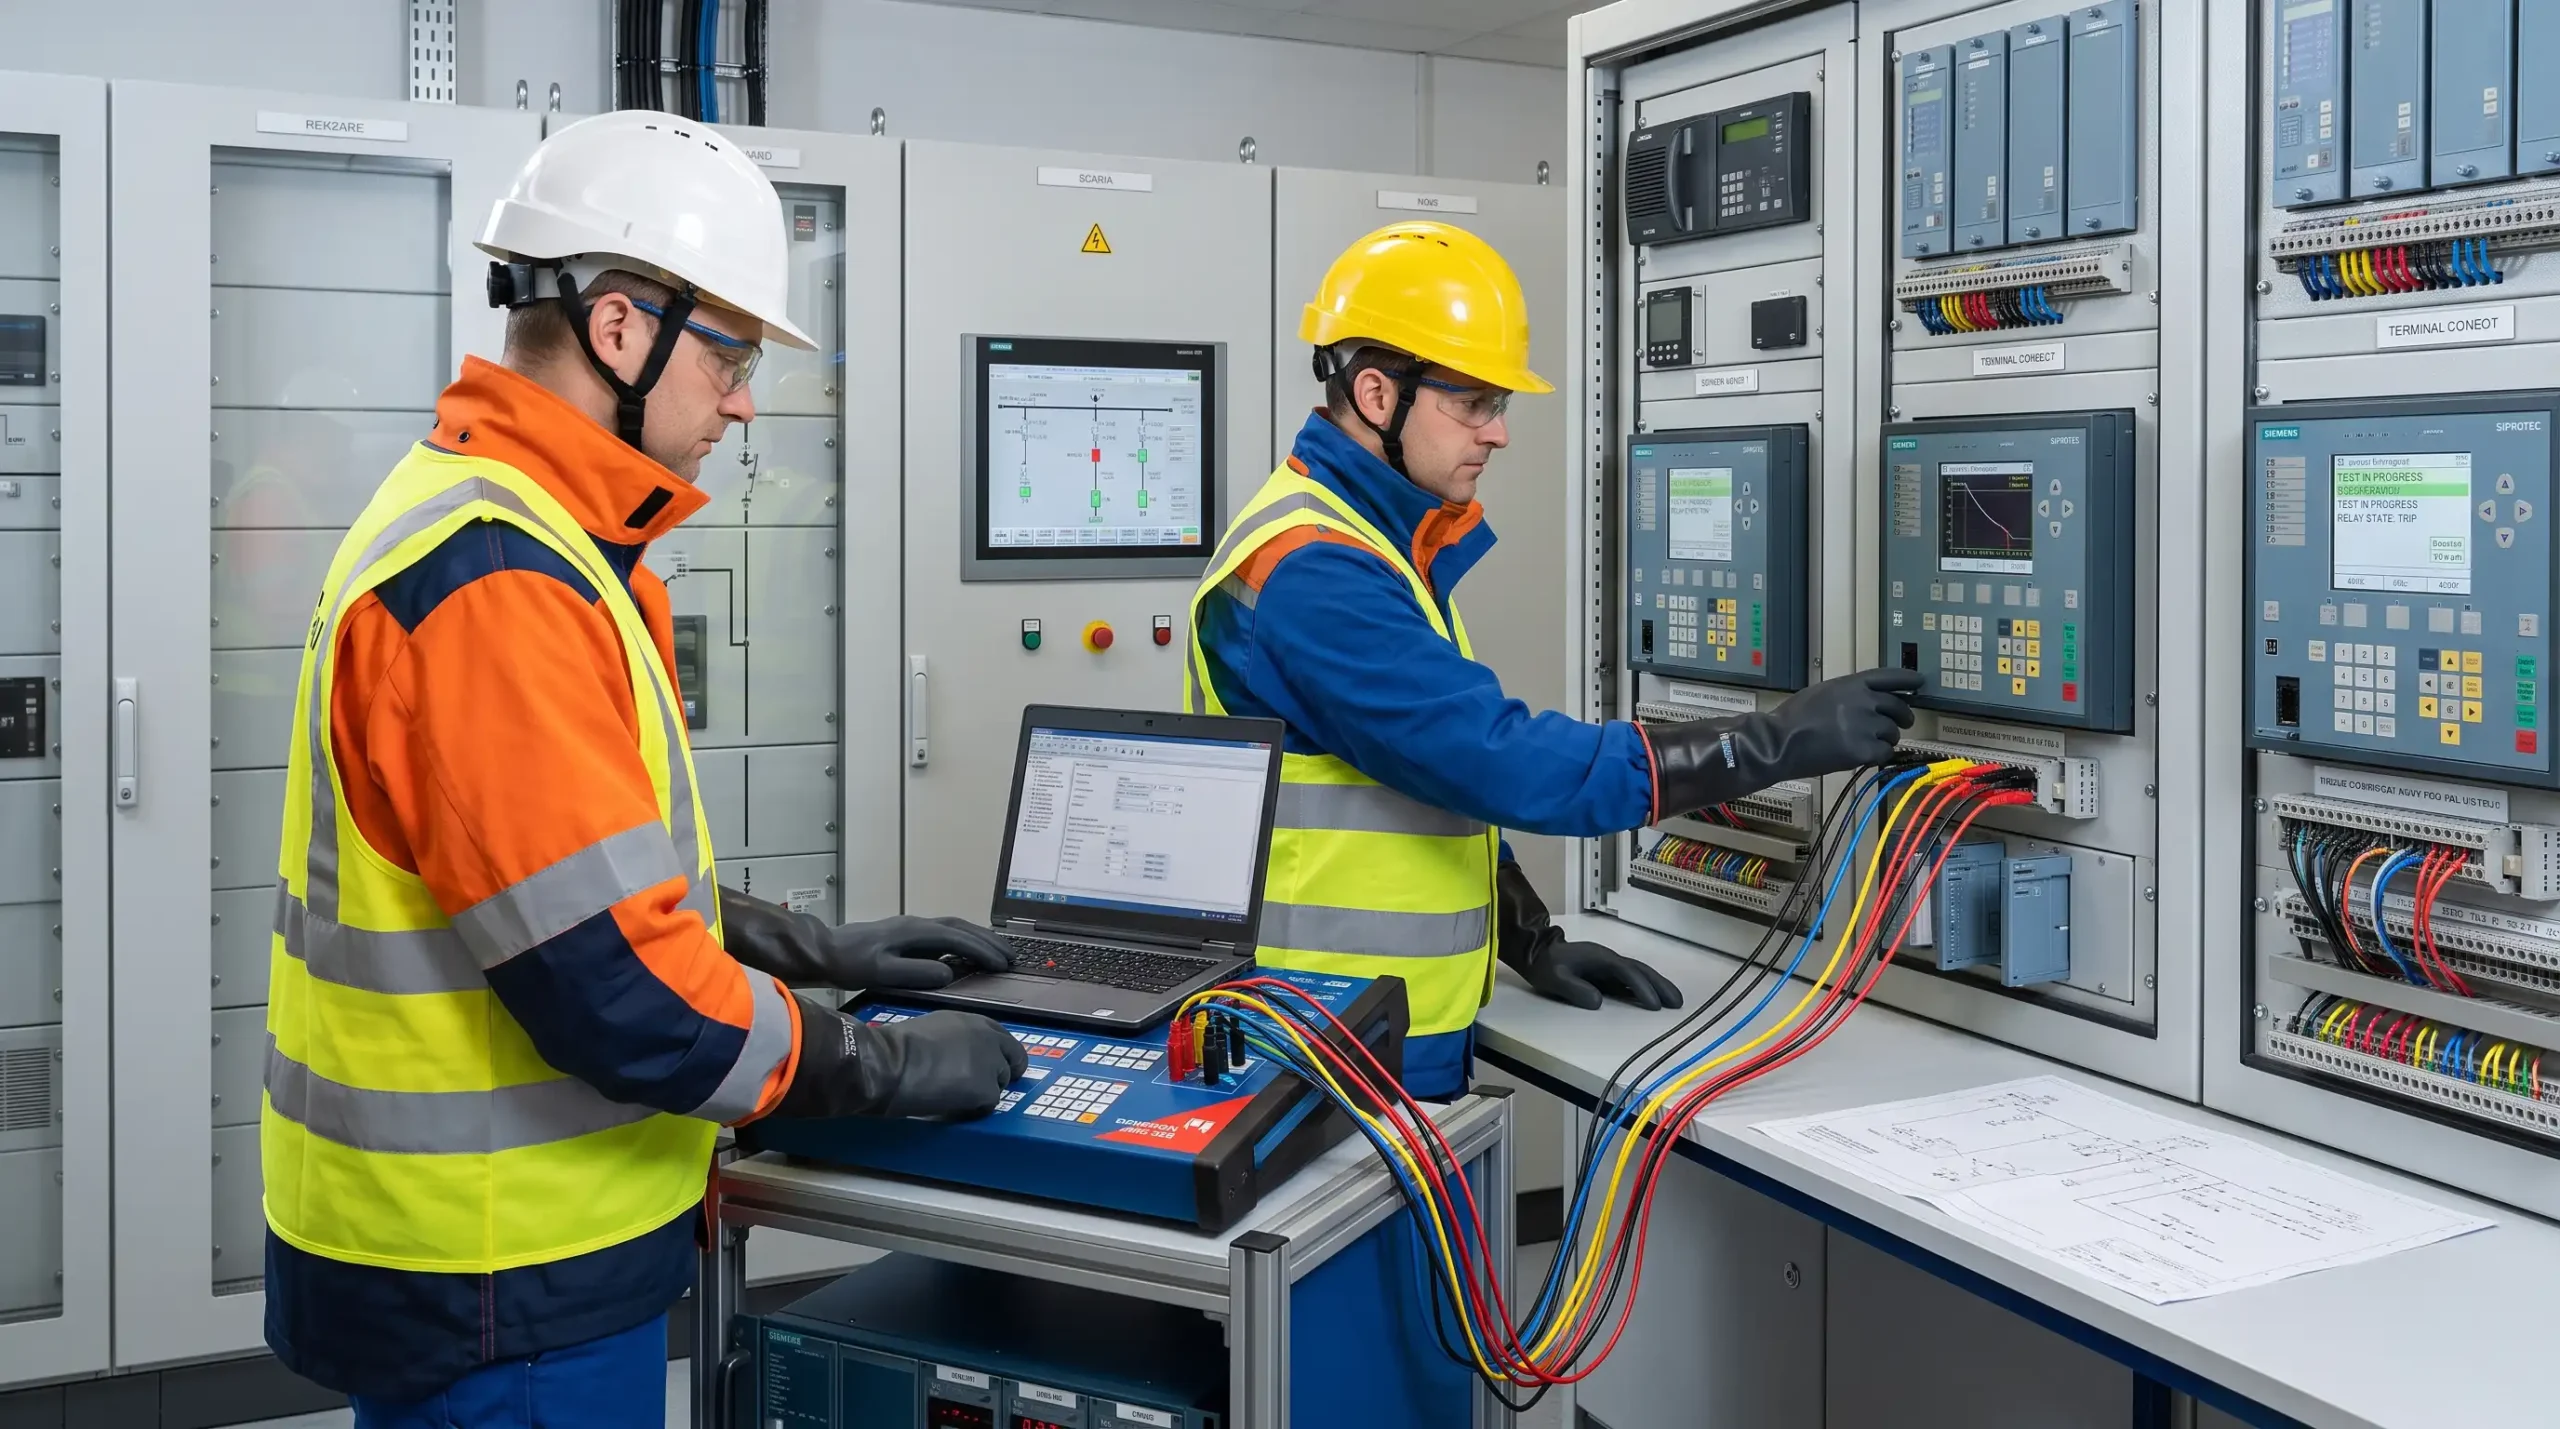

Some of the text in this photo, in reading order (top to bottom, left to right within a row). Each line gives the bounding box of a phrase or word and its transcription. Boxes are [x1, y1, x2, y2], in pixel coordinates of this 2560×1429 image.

[1079, 174, 1113, 184] SCARIA
[2388, 322, 2445, 336] TERMINAL
[2496, 421, 2541, 432] SIPROTEC
[2264, 429, 2298, 438] SIEMENS
[2337, 472, 2423, 482] TEST IN PROGRESS
[2337, 500, 2418, 509] TEST IN PROGRESS
[2337, 513, 2364, 523] RELAY
[2398, 513, 2417, 523] TRIP
[2444, 794, 2460, 804] PAL
